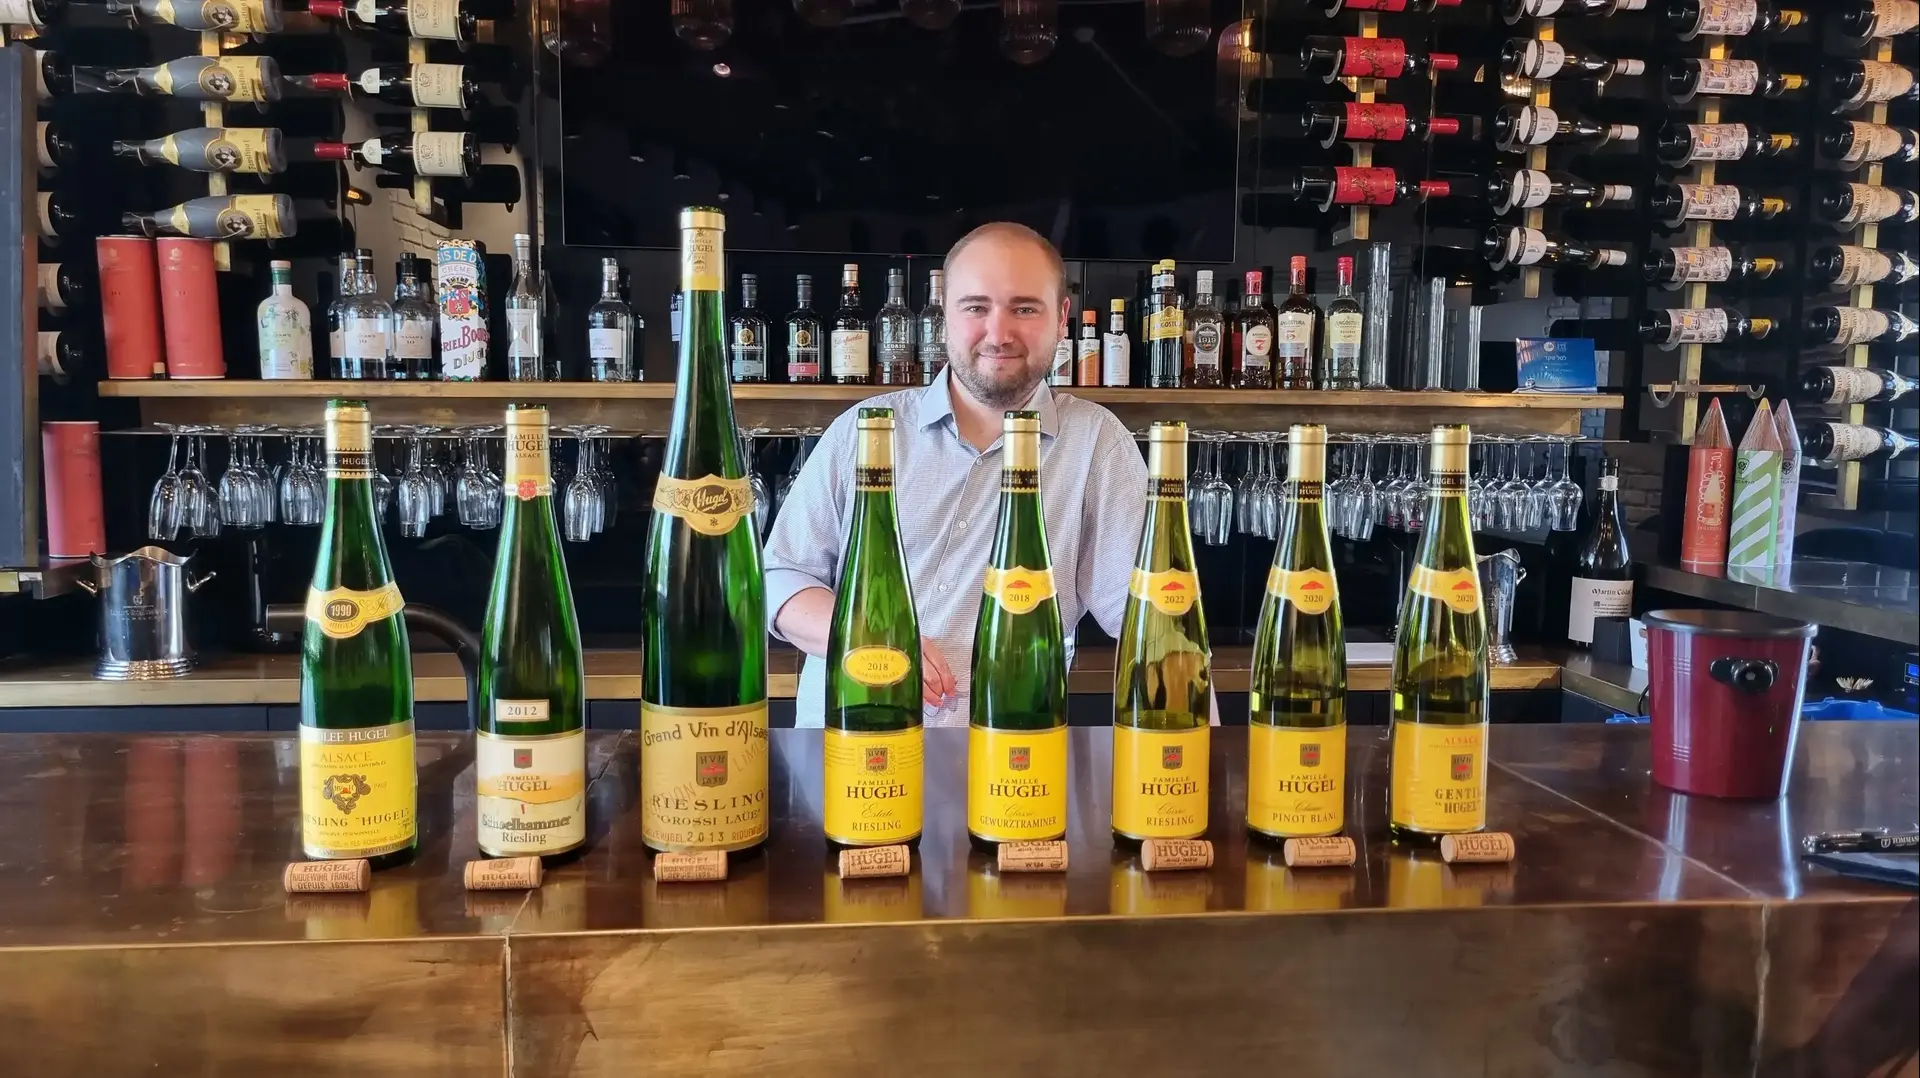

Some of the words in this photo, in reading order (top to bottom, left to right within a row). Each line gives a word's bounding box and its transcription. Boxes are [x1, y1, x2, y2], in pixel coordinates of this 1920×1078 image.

[453, 250, 467, 262] DE
[442, 337, 461, 353] RIEL
[507, 440, 550, 451] HUGEL
[342, 457, 369, 466] HUGEL
[1432, 477, 1456, 486] HUGEL
[694, 488, 729, 512] Hugel
[1008, 592, 1031, 604] 2018
[1164, 594, 1186, 605] 2022
[1302, 593, 1324, 605] 2020
[1455, 593, 1475, 605] 2020
[331, 604, 352, 617] 1990
[867, 662, 889, 672] 2018
[507, 706, 538, 716] 2012
[349, 728, 390, 742] HUGEL
[644, 723, 682, 747] Grand
[688, 721, 720, 738] Vin
[320, 751, 373, 764] ALSACE
[498, 779, 552, 793] HUGEL
[857, 778, 896, 786] FAMILLE
[1278, 779, 1336, 794] HUGEL
[846, 784, 908, 800] HUGEL
[989, 783, 1051, 798] HUGEL
[1141, 781, 1200, 797] HUGEL
[652, 790, 765, 812] RIESLING
[980, 815, 1058, 829] GEWURZTRAMINER
[1146, 815, 1195, 827] RIESLING
[1272, 813, 1306, 824] PINOT
[852, 820, 902, 832] RIESLING
[502, 831, 548, 845] Riesling
[687, 830, 724, 843] 2013
[1299, 837, 1346, 846] HUGEL
[1892, 835, 1920, 844] TOMMAS
[1157, 844, 1207, 857] HUGEL
[1459, 838, 1507, 851] HUGEL
[851, 851, 902, 866] HUGEL
[303, 863, 350, 873] HUGEL
[331, 871, 356, 881] FRANCE
[482, 872, 523, 881] HUGEL
[297, 881, 325, 890] DEPUIS
